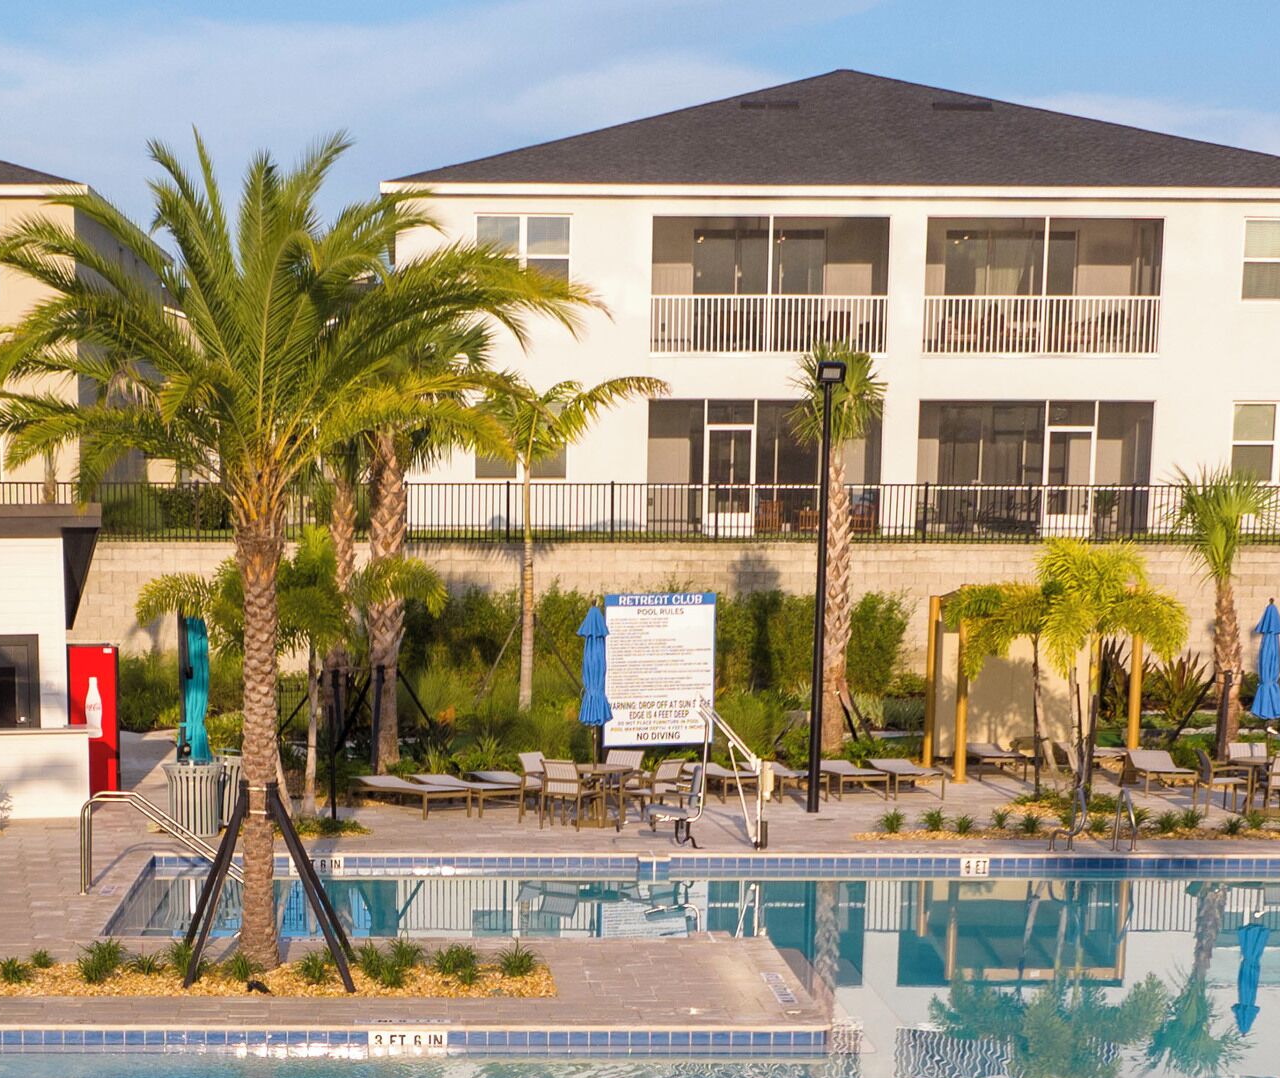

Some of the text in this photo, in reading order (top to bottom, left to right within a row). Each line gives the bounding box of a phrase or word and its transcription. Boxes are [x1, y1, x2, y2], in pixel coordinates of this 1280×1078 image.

[618, 594, 703, 605] RETREAT CLUB
[660, 607, 684, 615] RULES
[636, 732, 680, 741] NO DIVING
[331, 859, 341, 869] IN
[390, 1034, 406, 1046] FT
[429, 1034, 443, 1045] IN
